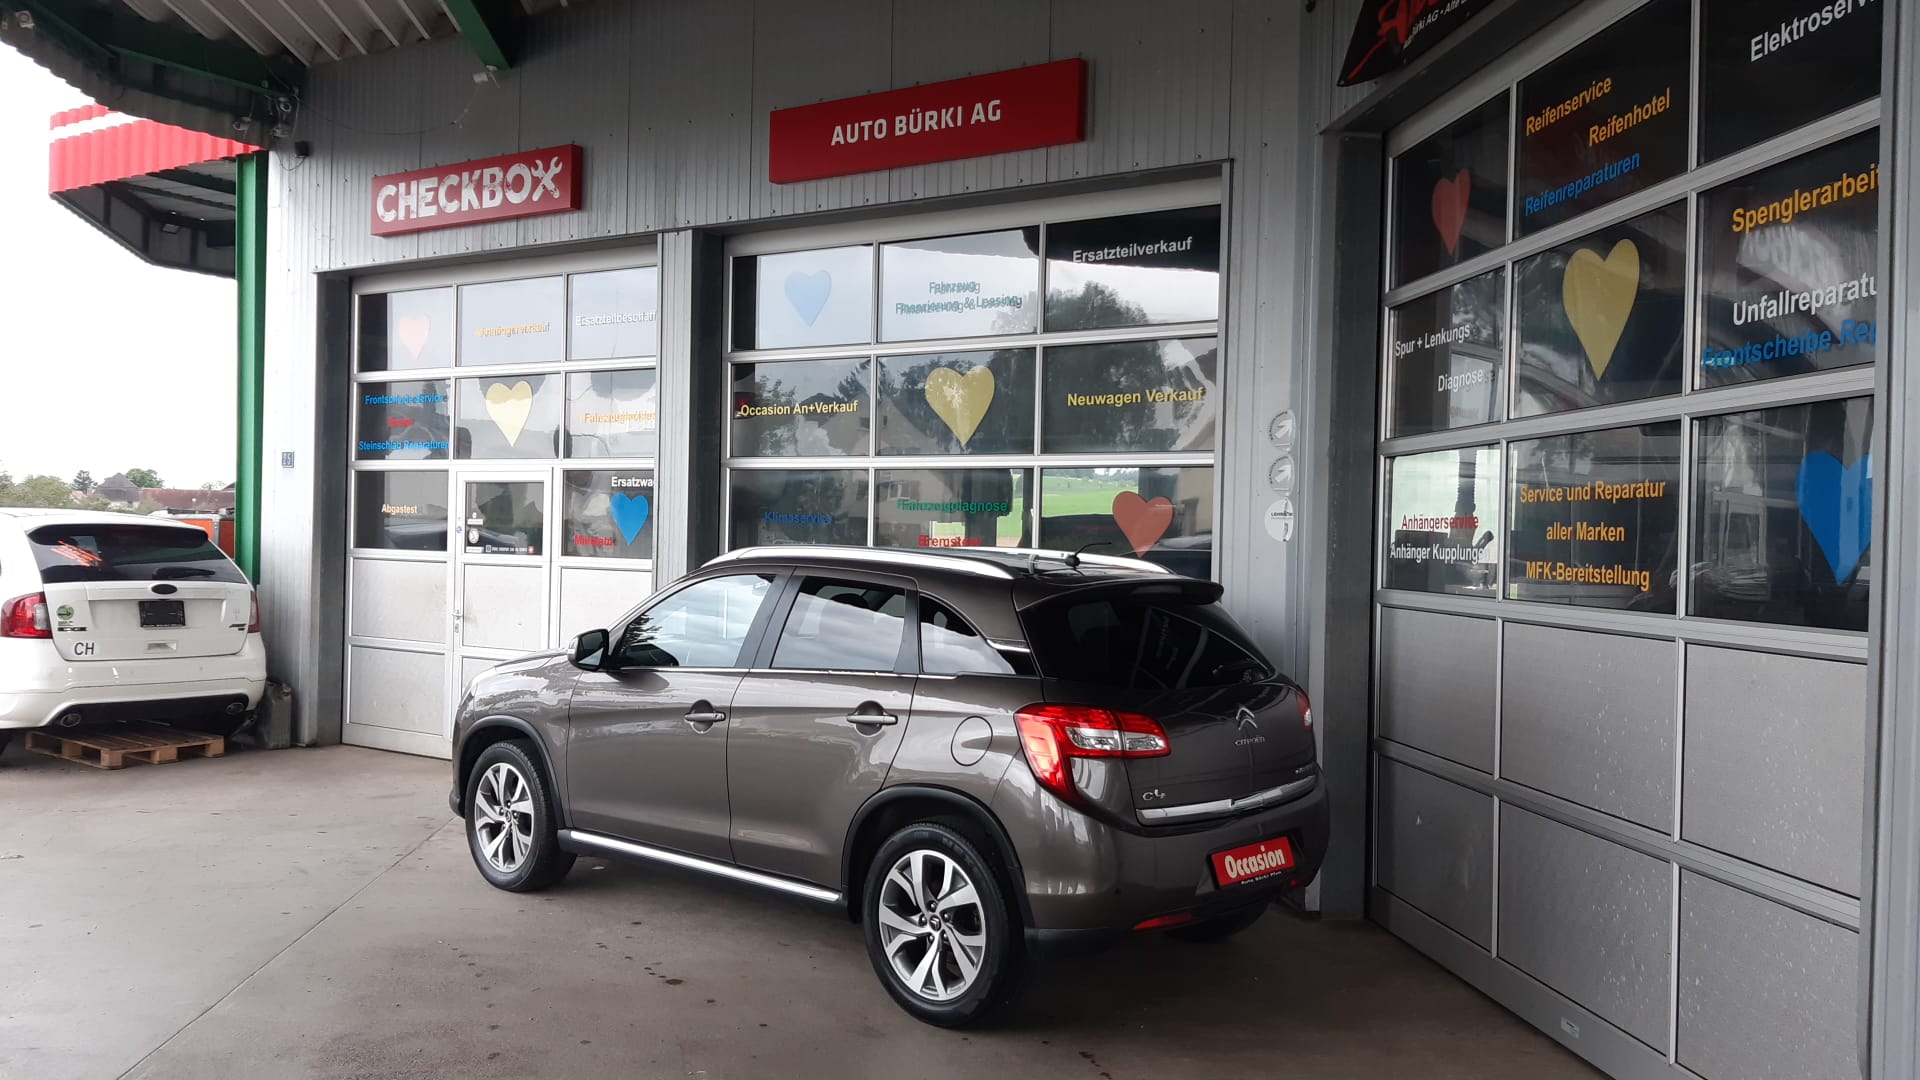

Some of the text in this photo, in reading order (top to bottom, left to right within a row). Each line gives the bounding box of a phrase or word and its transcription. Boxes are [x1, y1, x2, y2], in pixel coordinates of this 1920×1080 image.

[1425, 10, 1439, 26] AG
[1751, 0, 1874, 61] Elektroser
[1526, 77, 1612, 136] Reifenservice
[1589, 87, 1671, 147] Reifenhotel
[831, 99, 1001, 146] AUTO BÜRKI AG
[376, 156, 563, 223] CHECKBOX
[1525, 152, 1640, 216] Reifenreparaturen
[1072, 236, 1193, 264] Ersatzteilverkauf
[929, 281, 981, 295] Fahrzeug
[1395, 340, 1415, 359] Spur
[1424, 324, 1470, 348] Lenkungs
[1702, 327, 1832, 370] Frontscheibe
[1437, 369, 1484, 392] Diagnose
[740, 400, 859, 416] Occasion An+Verkauf
[1067, 387, 1205, 408] Neuwagen Verkauf
[359, 440, 402, 450] Steinschlag
[611, 476, 653, 487] Ersatzwa
[1520, 479, 1665, 504] Service und Reparatur
[381, 504, 417, 515] Abgastest
[897, 498, 1008, 513] Fahrzeugdiagnose
[764, 512, 833, 524] Klimaservice
[1401, 512, 1479, 533] Anhängerservice
[1546, 521, 1625, 542] aller Marken
[1390, 543, 1486, 564] Anhänger Kupplunge
[1526, 561, 1650, 592] MFK-Bereitstellung
[74, 642, 95, 656] CH
[1142, 788, 1166, 801] C4
[1224, 845, 1286, 879] Occasion
